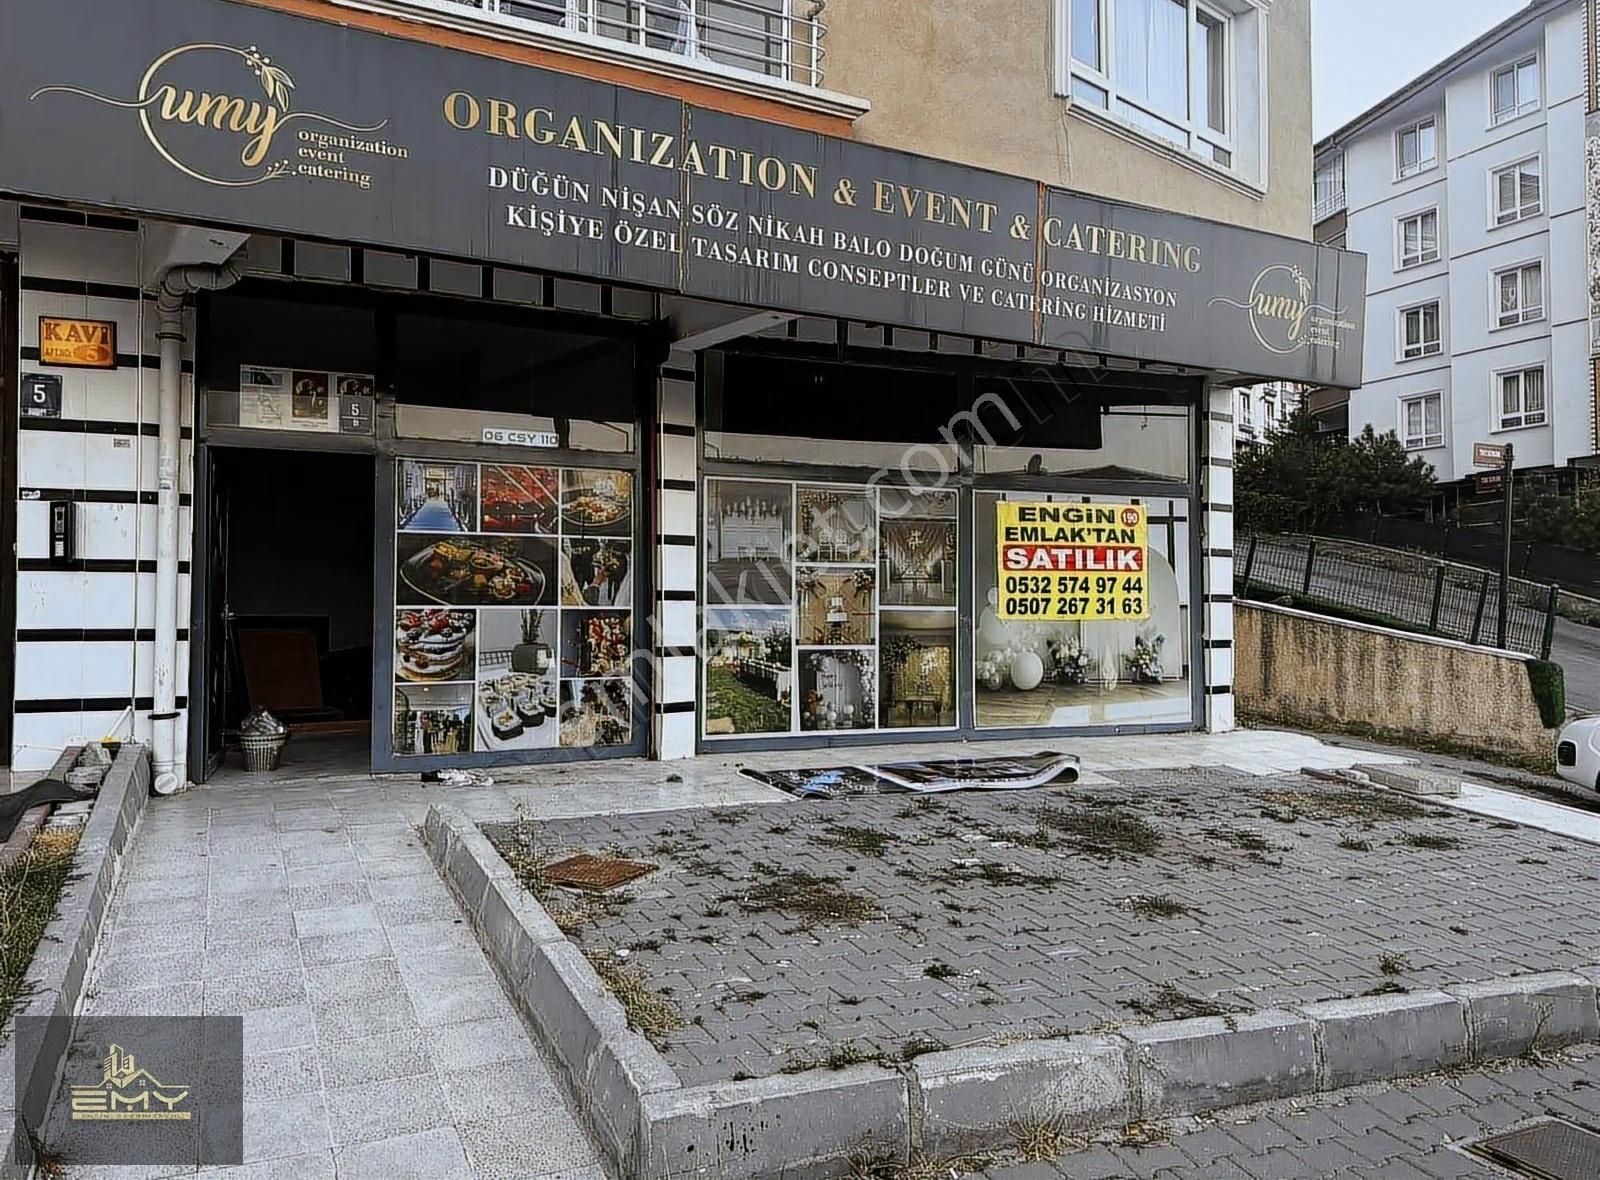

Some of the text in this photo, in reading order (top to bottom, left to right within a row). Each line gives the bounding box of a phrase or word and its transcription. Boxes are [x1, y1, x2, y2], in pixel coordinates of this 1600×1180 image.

[158, 85, 279, 167] umy
[298, 129, 409, 158] organization
[298, 146, 345, 164] event
[298, 161, 372, 188] catering
[443, 91, 1202, 274] ORGANIZATION & EVENT & CATERING
[488, 166, 1178, 308] DÜĞÜN NİŞAN SÖZ NİKAH BALO DOĞUM GÜNÜ ORGANİZASYON
[506, 204, 1166, 333] KİŞİYE ÖZEL TASARIM CONSEPTLER VE CATERİNG HİZMETİ
[33, 384, 46, 403] 5
[352, 404, 359, 416] 5
[484, 430, 503, 441] 06
[507, 432, 537, 444] CSY
[1004, 526, 1136, 543] EMLAK'TAN
[1006, 547, 1141, 570] SATILIK
[1006, 576, 1143, 594] 0532 574 97 44
[1006, 597, 1143, 615] 0507 267 31 63
